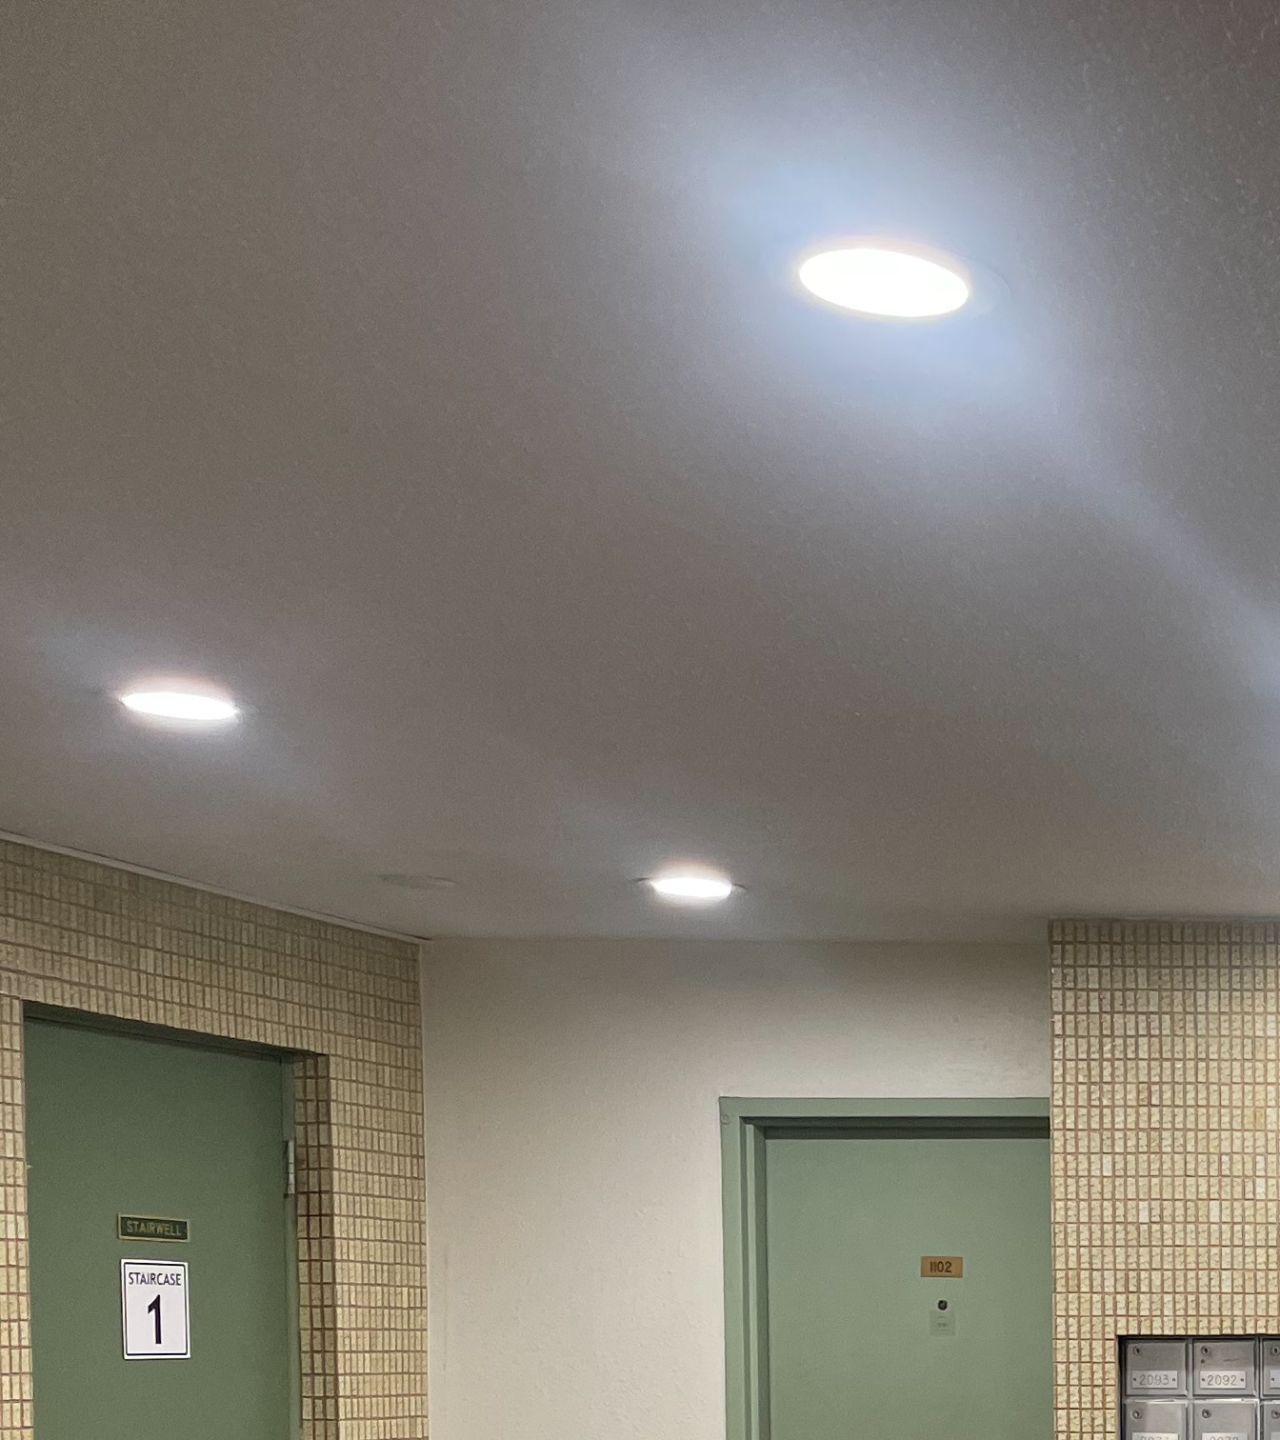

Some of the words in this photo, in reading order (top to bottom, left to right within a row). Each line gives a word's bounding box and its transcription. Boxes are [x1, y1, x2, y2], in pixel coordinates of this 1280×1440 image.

[126, 1220, 182, 1236] STAIRWELL
[128, 1271, 182, 1286] STAIRCASE
[147, 1293, 162, 1345] 1
[1139, 1373, 1170, 1386] 2093
[1207, 1374, 1238, 1386] 2092
